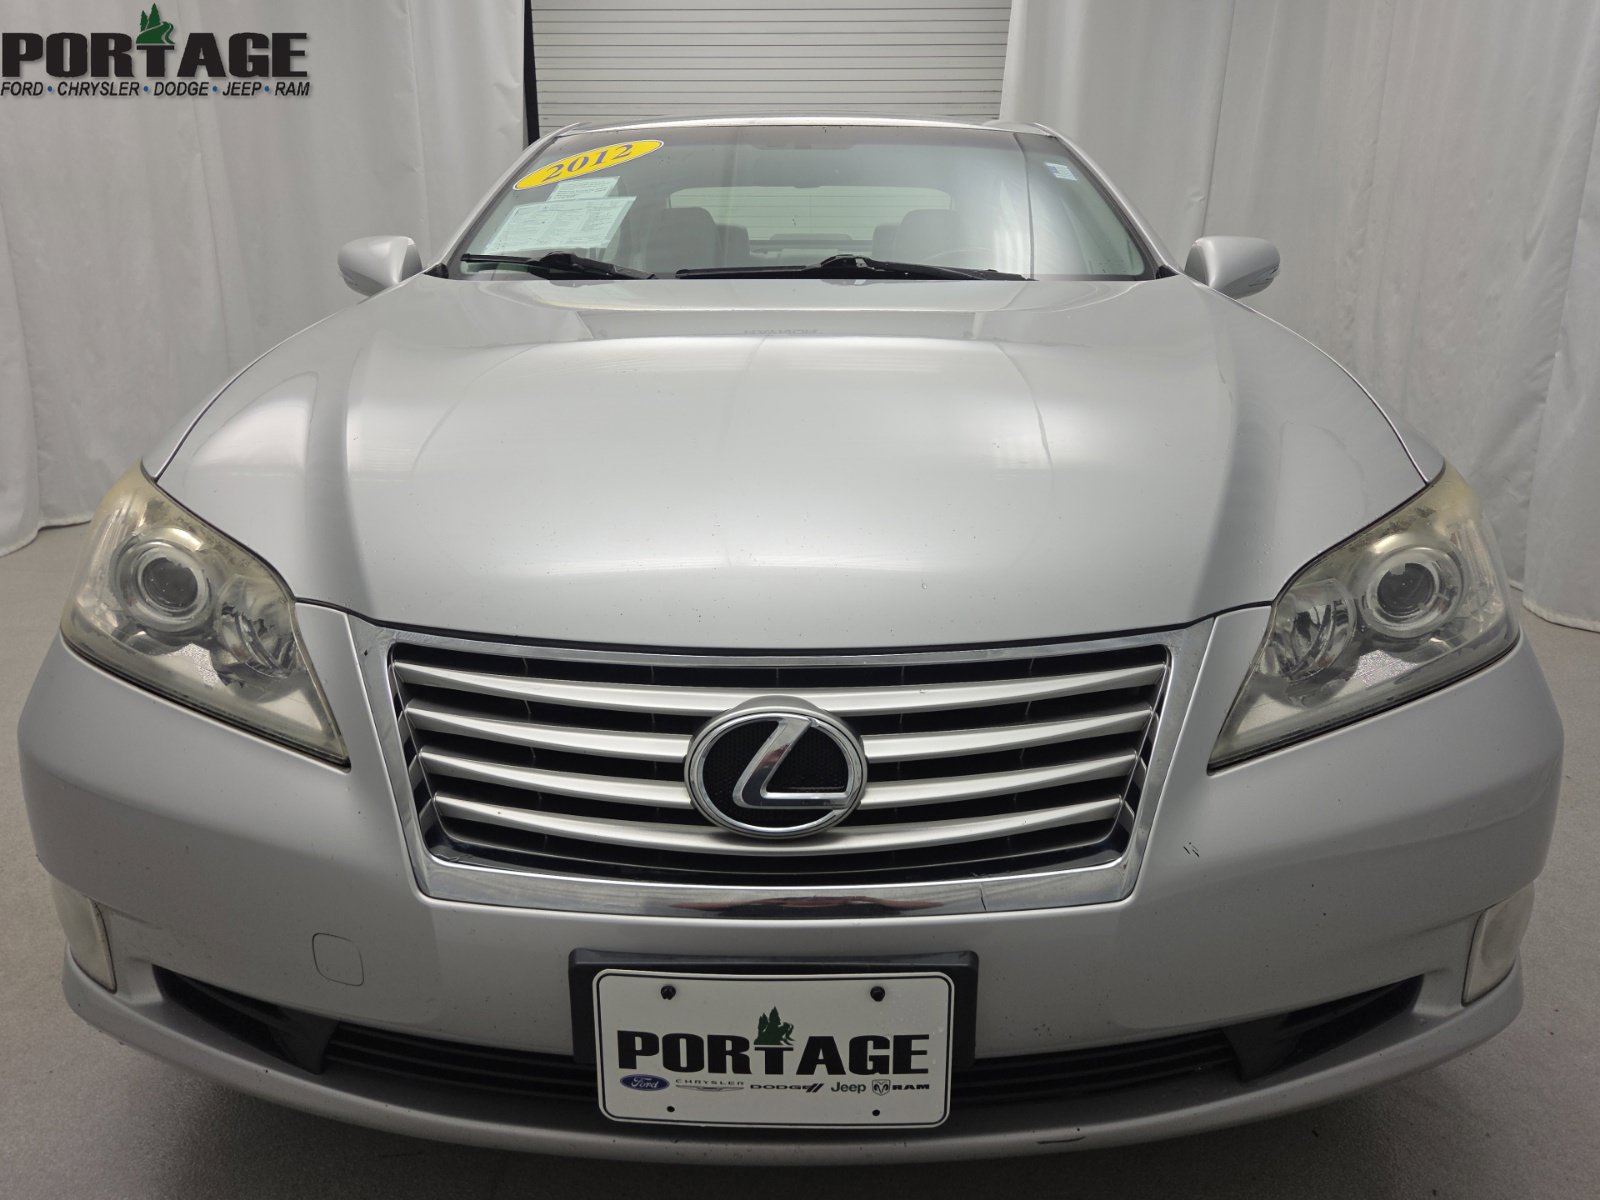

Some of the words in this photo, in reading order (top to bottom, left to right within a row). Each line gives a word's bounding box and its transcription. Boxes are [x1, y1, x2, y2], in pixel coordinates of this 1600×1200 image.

[542, 144, 634, 182] 2012
[617, 1030, 930, 1075] PORTAGE
[675, 1078, 745, 1086] CHRYSLER
[831, 1081, 867, 1094] Jeep
